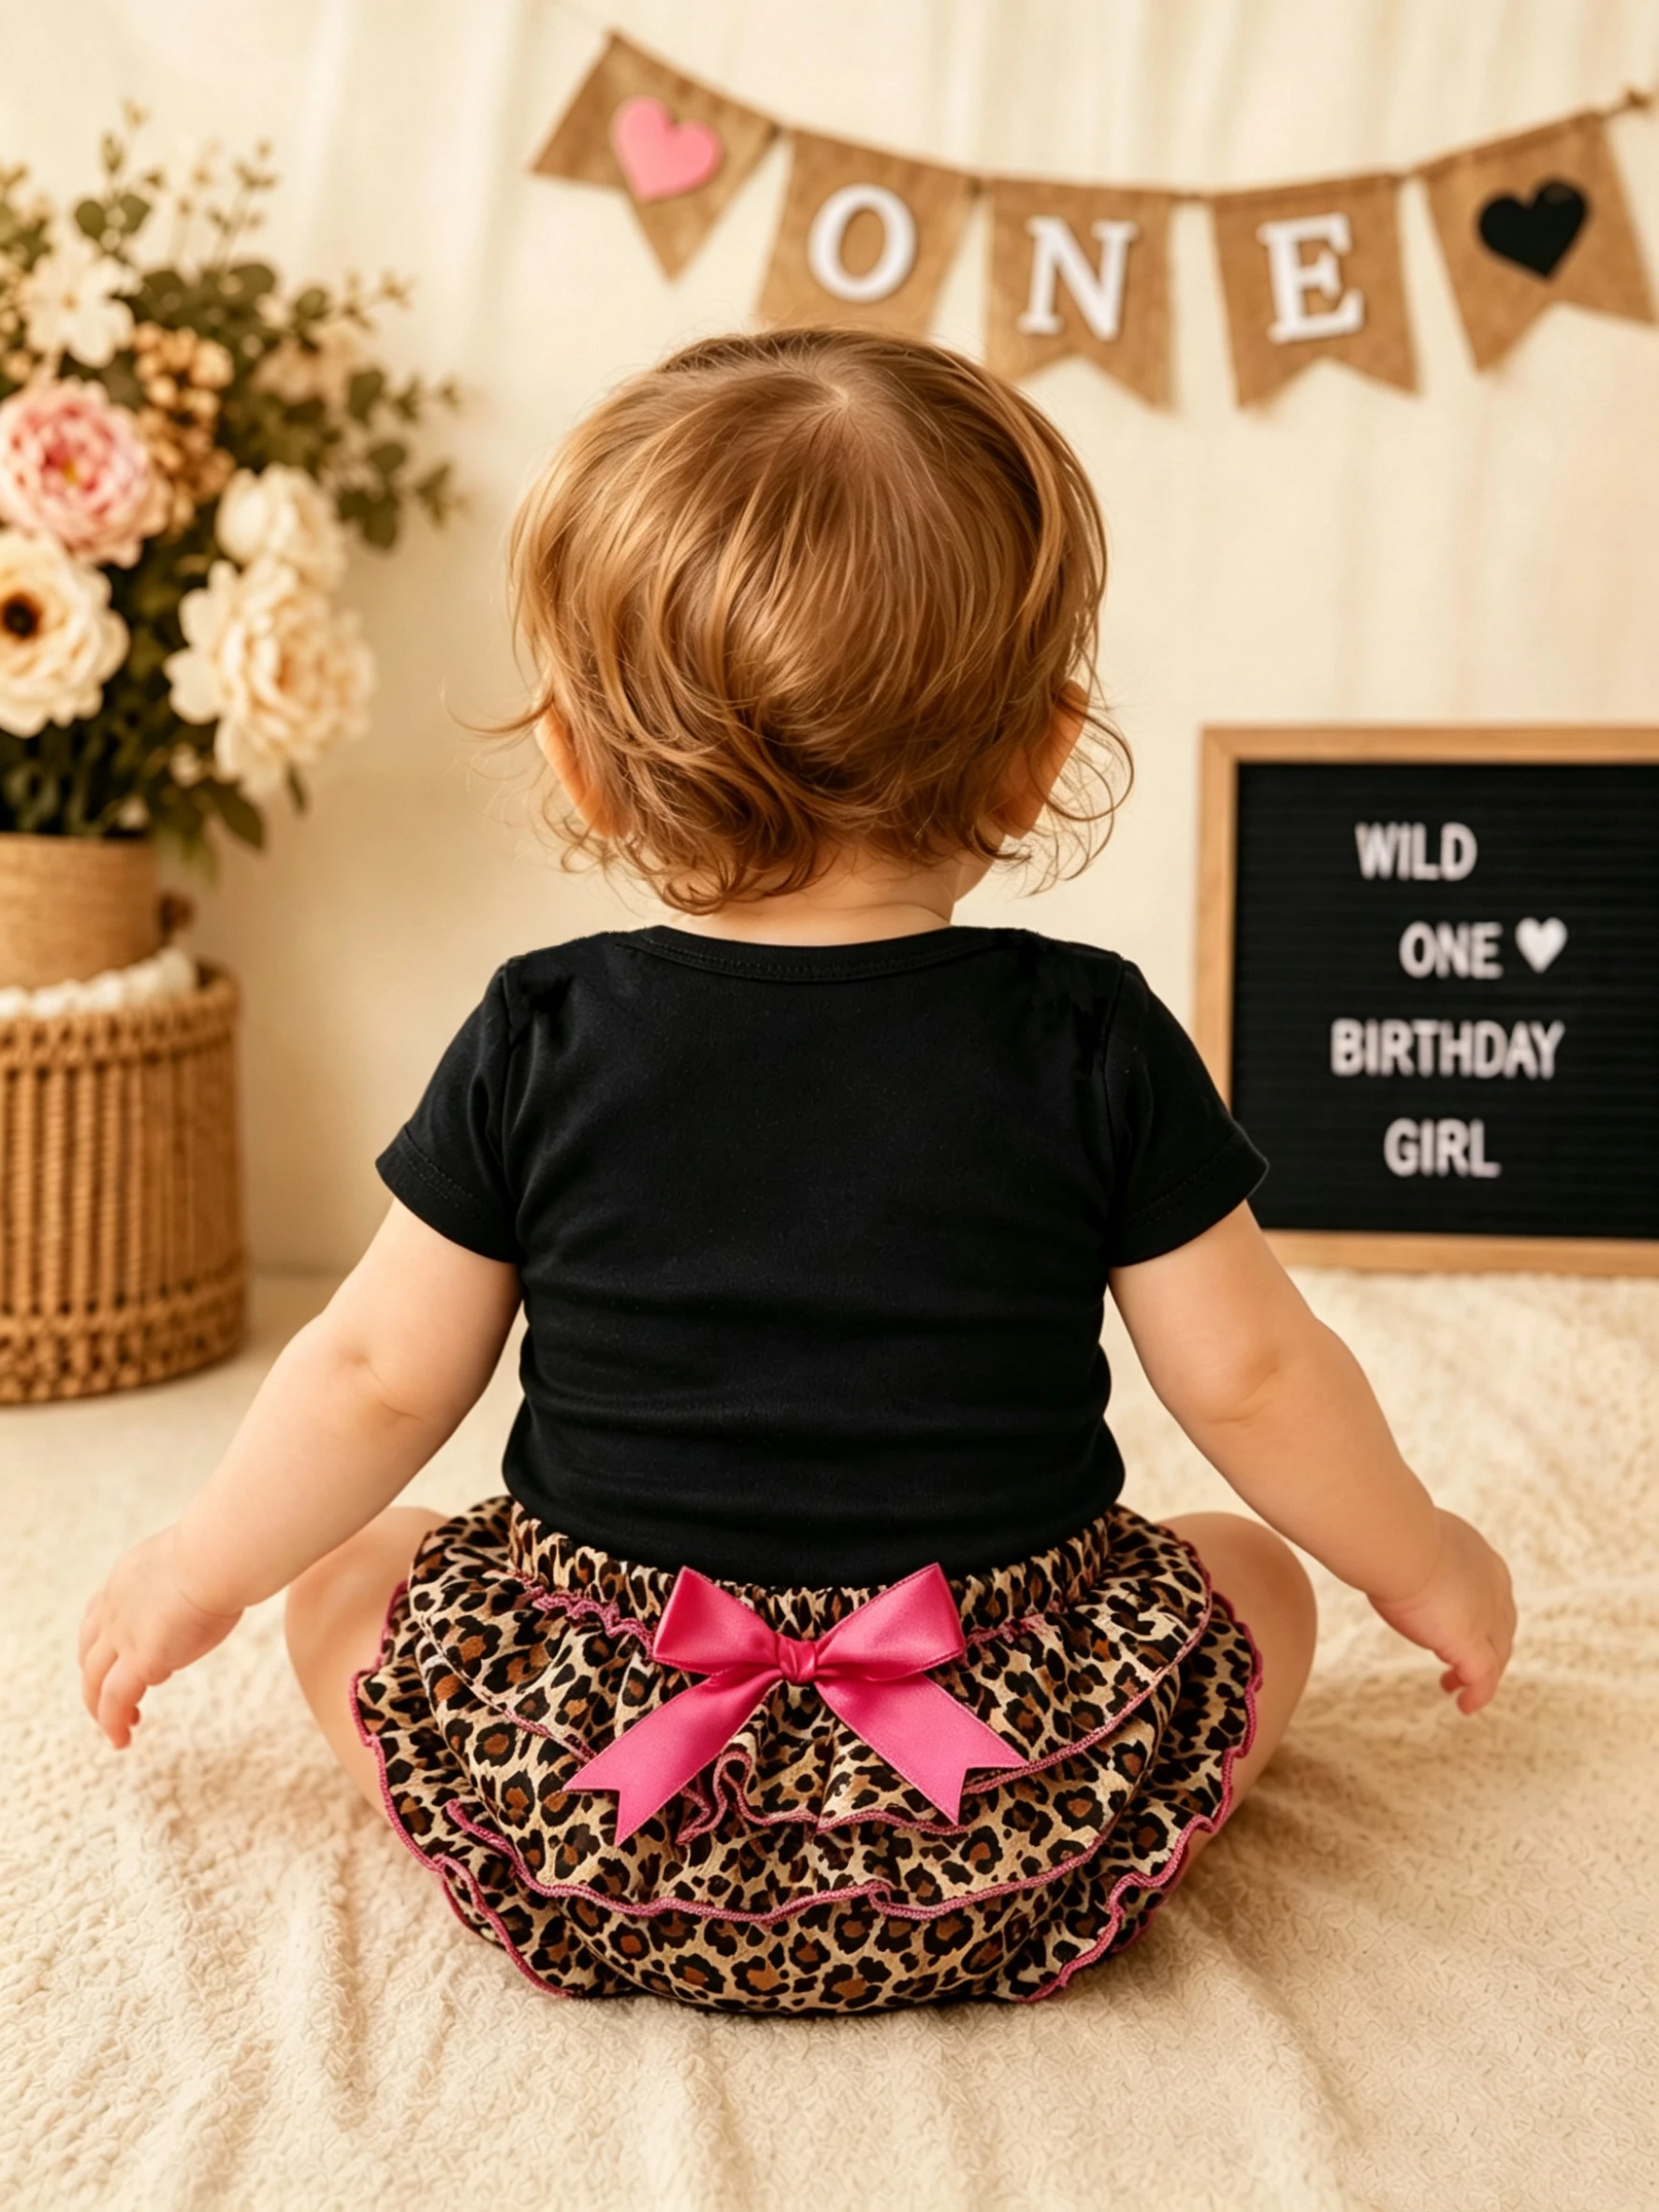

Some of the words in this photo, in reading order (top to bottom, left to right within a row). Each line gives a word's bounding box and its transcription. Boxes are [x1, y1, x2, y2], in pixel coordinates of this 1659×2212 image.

[808, 184, 1364, 342] ONE
[1354, 822, 1478, 881] WILD
[1399, 921, 1503, 979] ONE
[1331, 1018, 1565, 1078] BIRTHDAY
[1383, 1117, 1501, 1178] GIRL
